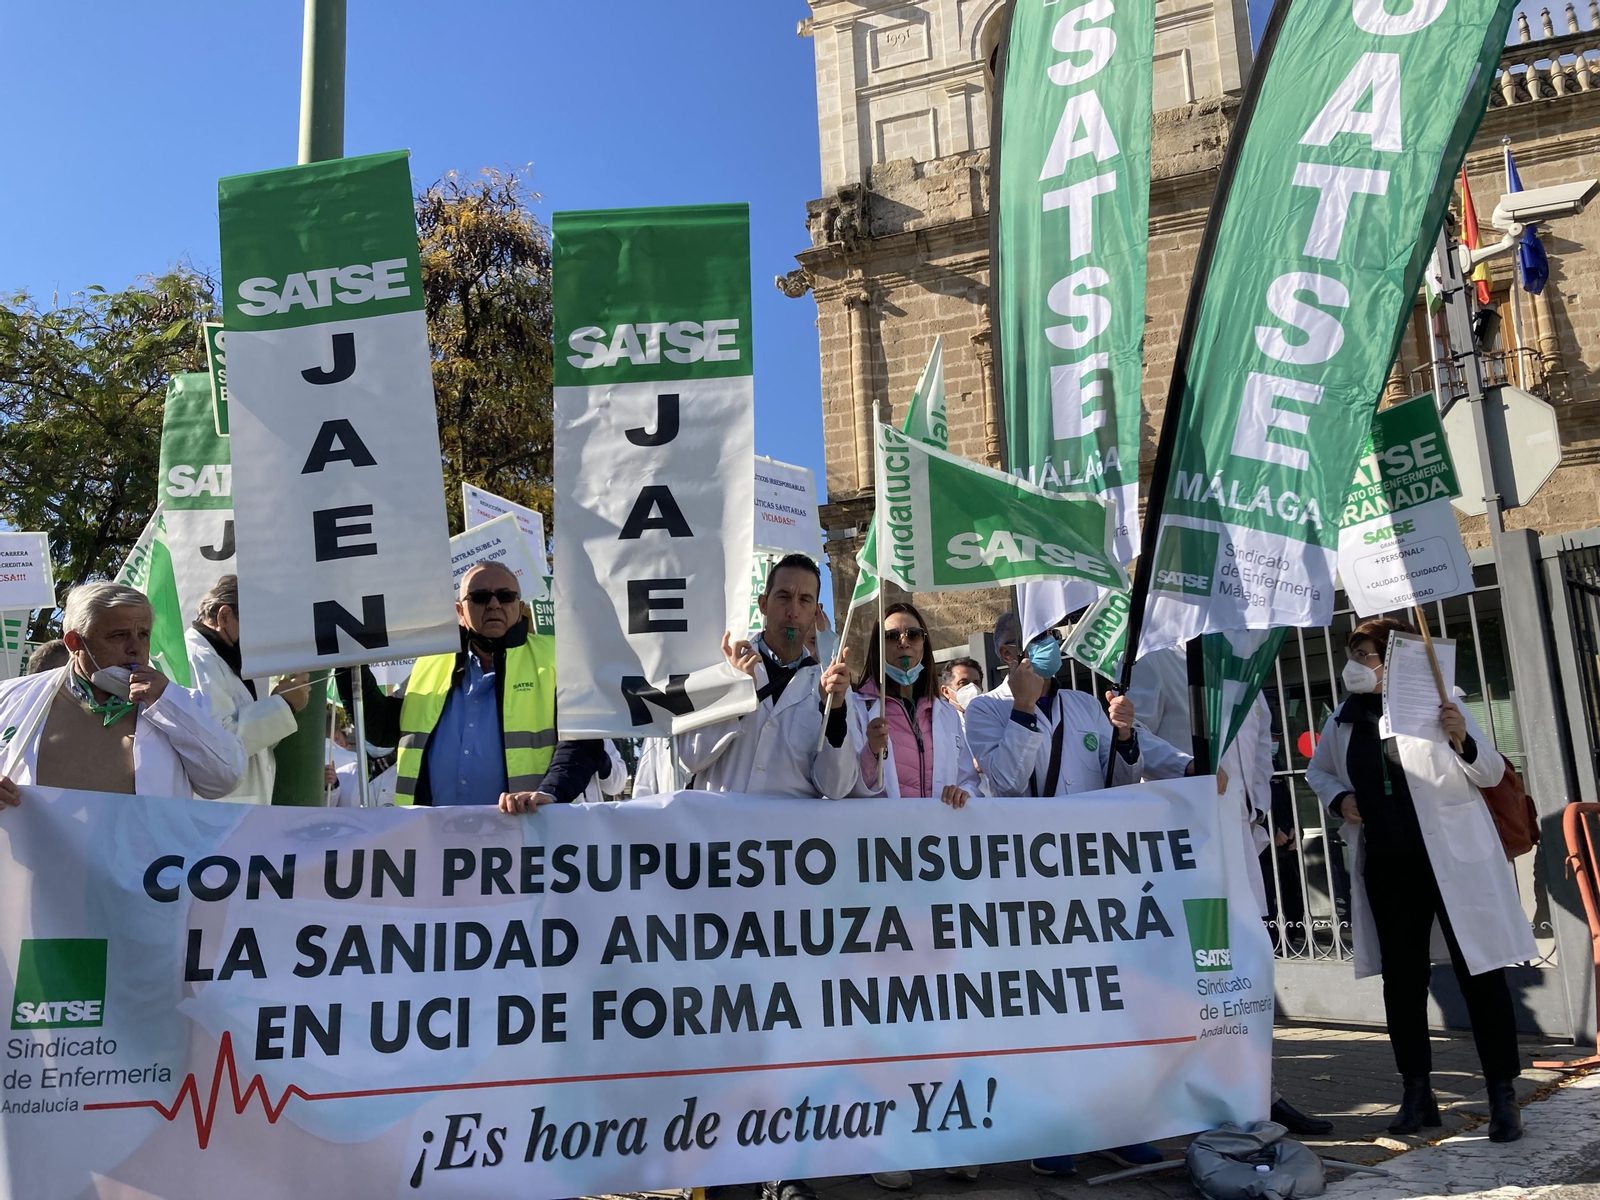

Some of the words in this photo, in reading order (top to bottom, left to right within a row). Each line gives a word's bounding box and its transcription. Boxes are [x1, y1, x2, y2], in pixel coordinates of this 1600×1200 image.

[886, 28, 910, 47] 1991
[236, 257, 411, 317] SATSE
[566, 318, 741, 369] SATSE
[1368, 484, 1382, 497] DE
[1383, 461, 1449, 491] ENFERMERIA
[301, 332, 389, 656] JAEN
[1173, 469, 1322, 529] MÁLAGA
[775, 503, 807, 516] SANITARIAS
[475, 541, 492, 553] SUBE
[491, 537, 502, 546] LA
[1363, 519, 1416, 545] SATSE
[1380, 538, 1405, 549] GRANADA
[488, 548, 507, 561] COVID
[618, 394, 694, 727] JAEN
[945, 531, 1111, 578] SATSE
[1225, 543, 1290, 571] Sindicato
[1157, 569, 1209, 589] SATSE
[1221, 563, 1239, 578] de
[1243, 569, 1321, 601] Enfermería
[1400, 574, 1410, 582] DE
[1410, 564, 1448, 578] CUIDADOS
[1219, 581, 1266, 607] Málaga
[143, 854, 296, 902] CON
[323, 849, 415, 899] UN
[442, 838, 836, 896] PRESUPUESTO
[859, 828, 1197, 883] INSUFICIENTE
[184, 927, 267, 982] LA
[292, 918, 579, 978] SANIDAD
[600, 906, 913, 965] ANDALUZA
[933, 881, 1174, 950] ENTRARÁ
[1197, 976, 1252, 996] Sindicato
[15, 1000, 102, 1023] SATSE
[255, 1002, 342, 1060] EN
[370, 997, 470, 1054] UCI
[497, 992, 567, 1047] DE
[593, 980, 801, 1040] FORMA
[822, 965, 1124, 1030] INMINENTE
[1200, 1004, 1219, 1020] de
[1223, 996, 1272, 1018] Enfermería
[1200, 1023, 1248, 1039] Andalucía
[6, 1036, 117, 1059] Sindicato
[3, 1069, 32, 1090] de
[41, 1063, 171, 1089] Enfermería
[1, 1098, 79, 1114] Andalucía
[409, 1112, 506, 1188] ¡Es
[524, 1104, 646, 1163] hora
[663, 1094, 721, 1152] de
[736, 1095, 896, 1147] actuar
[908, 1076, 998, 1133] YA!
